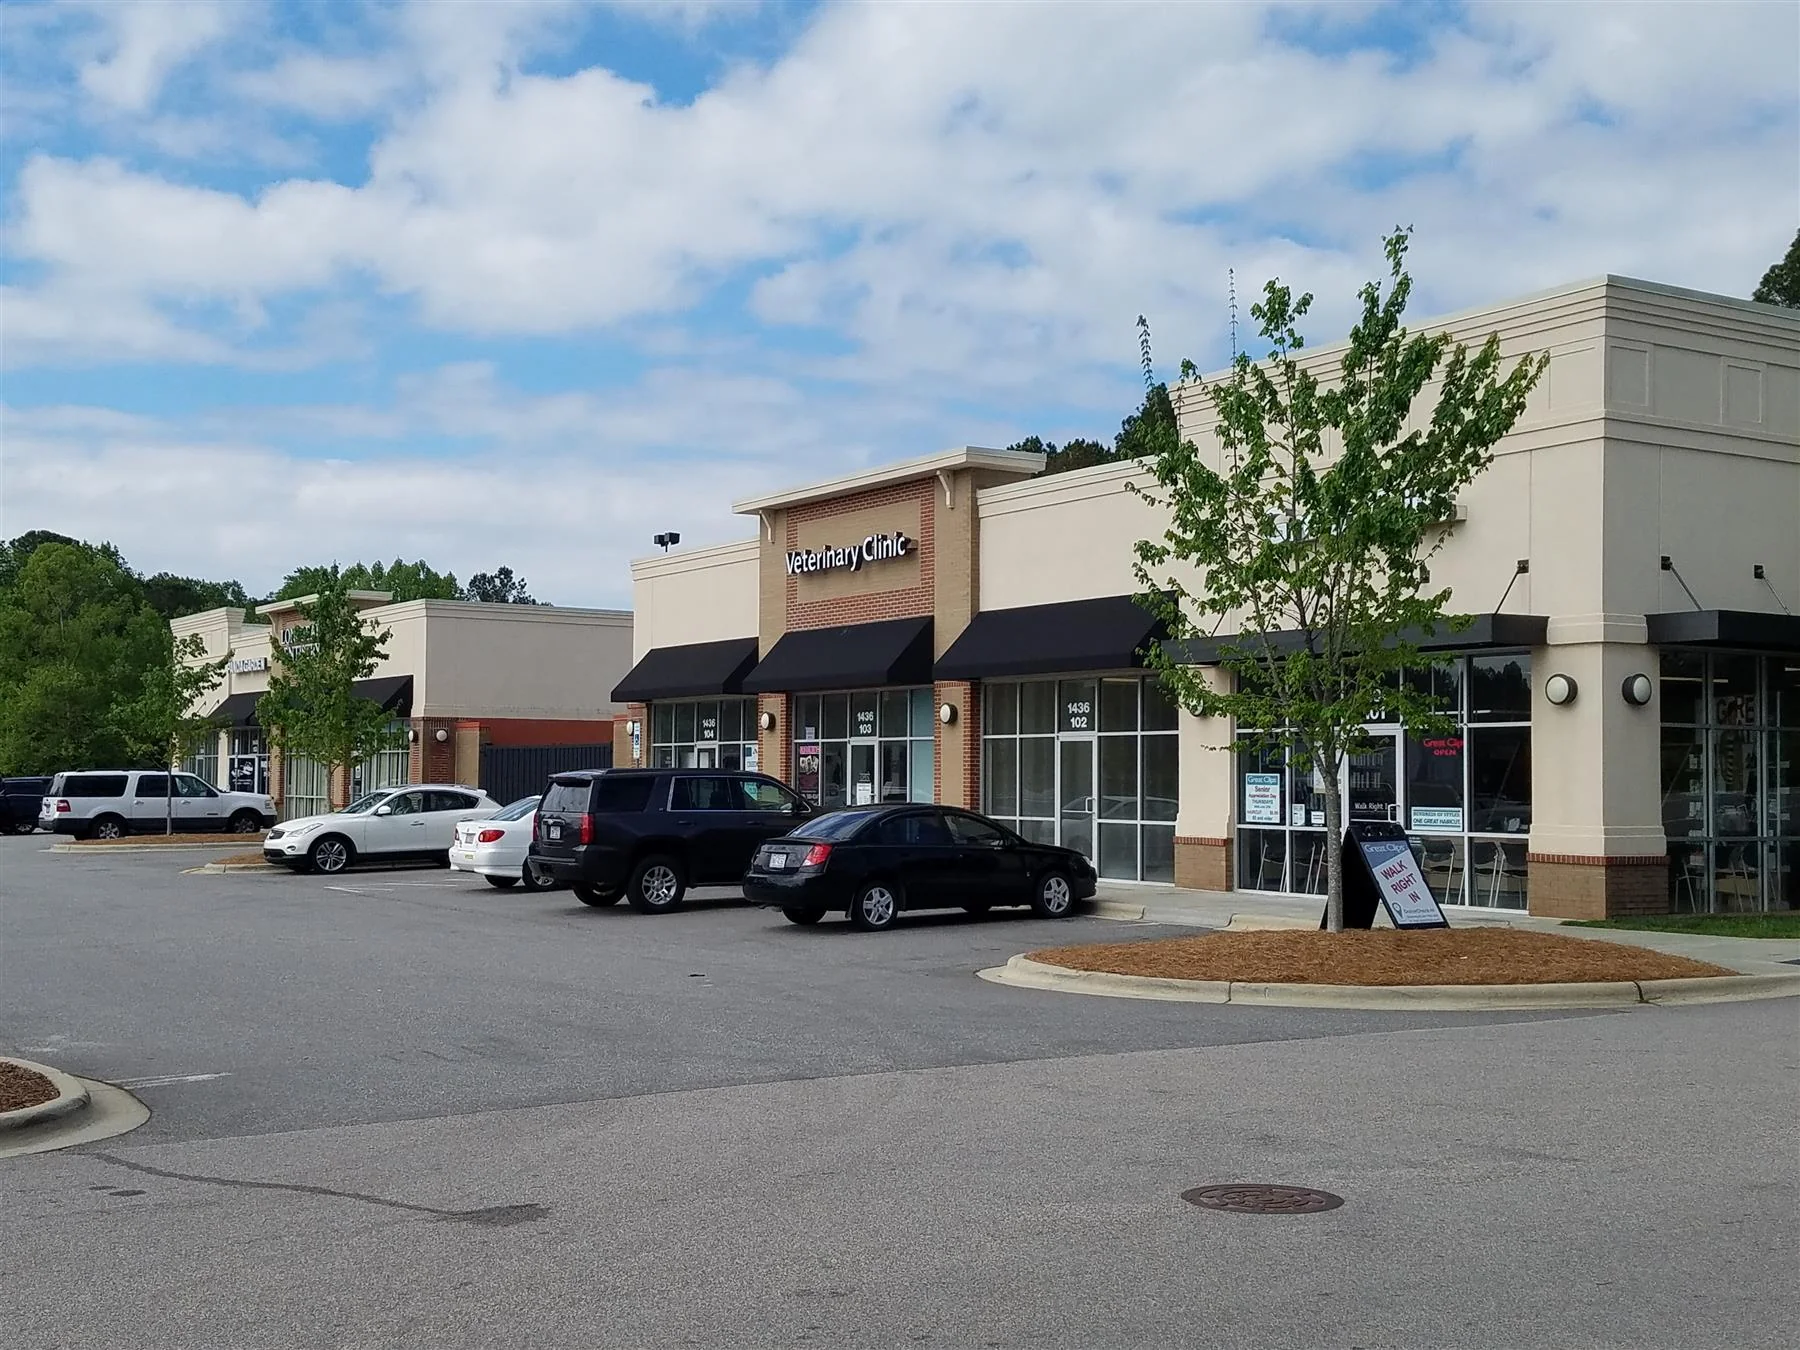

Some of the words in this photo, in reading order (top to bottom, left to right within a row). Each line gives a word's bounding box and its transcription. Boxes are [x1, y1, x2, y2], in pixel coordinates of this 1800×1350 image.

[785, 544, 859, 574] Veterinary
[862, 532, 906, 561] Clinic
[1067, 702, 1090, 713] 1436
[857, 711, 874, 722] 1436
[1070, 716, 1087, 728] 102
[702, 718, 716, 728] 1436
[704, 729, 714, 739] 104
[859, 724, 872, 734] 103
[1368, 802, 1384, 811] Right
[1364, 844, 1386, 852] Great
[1380, 859, 1408, 881] WALK
[1390, 873, 1418, 894] RIGHT
[1408, 891, 1422, 904] IN
